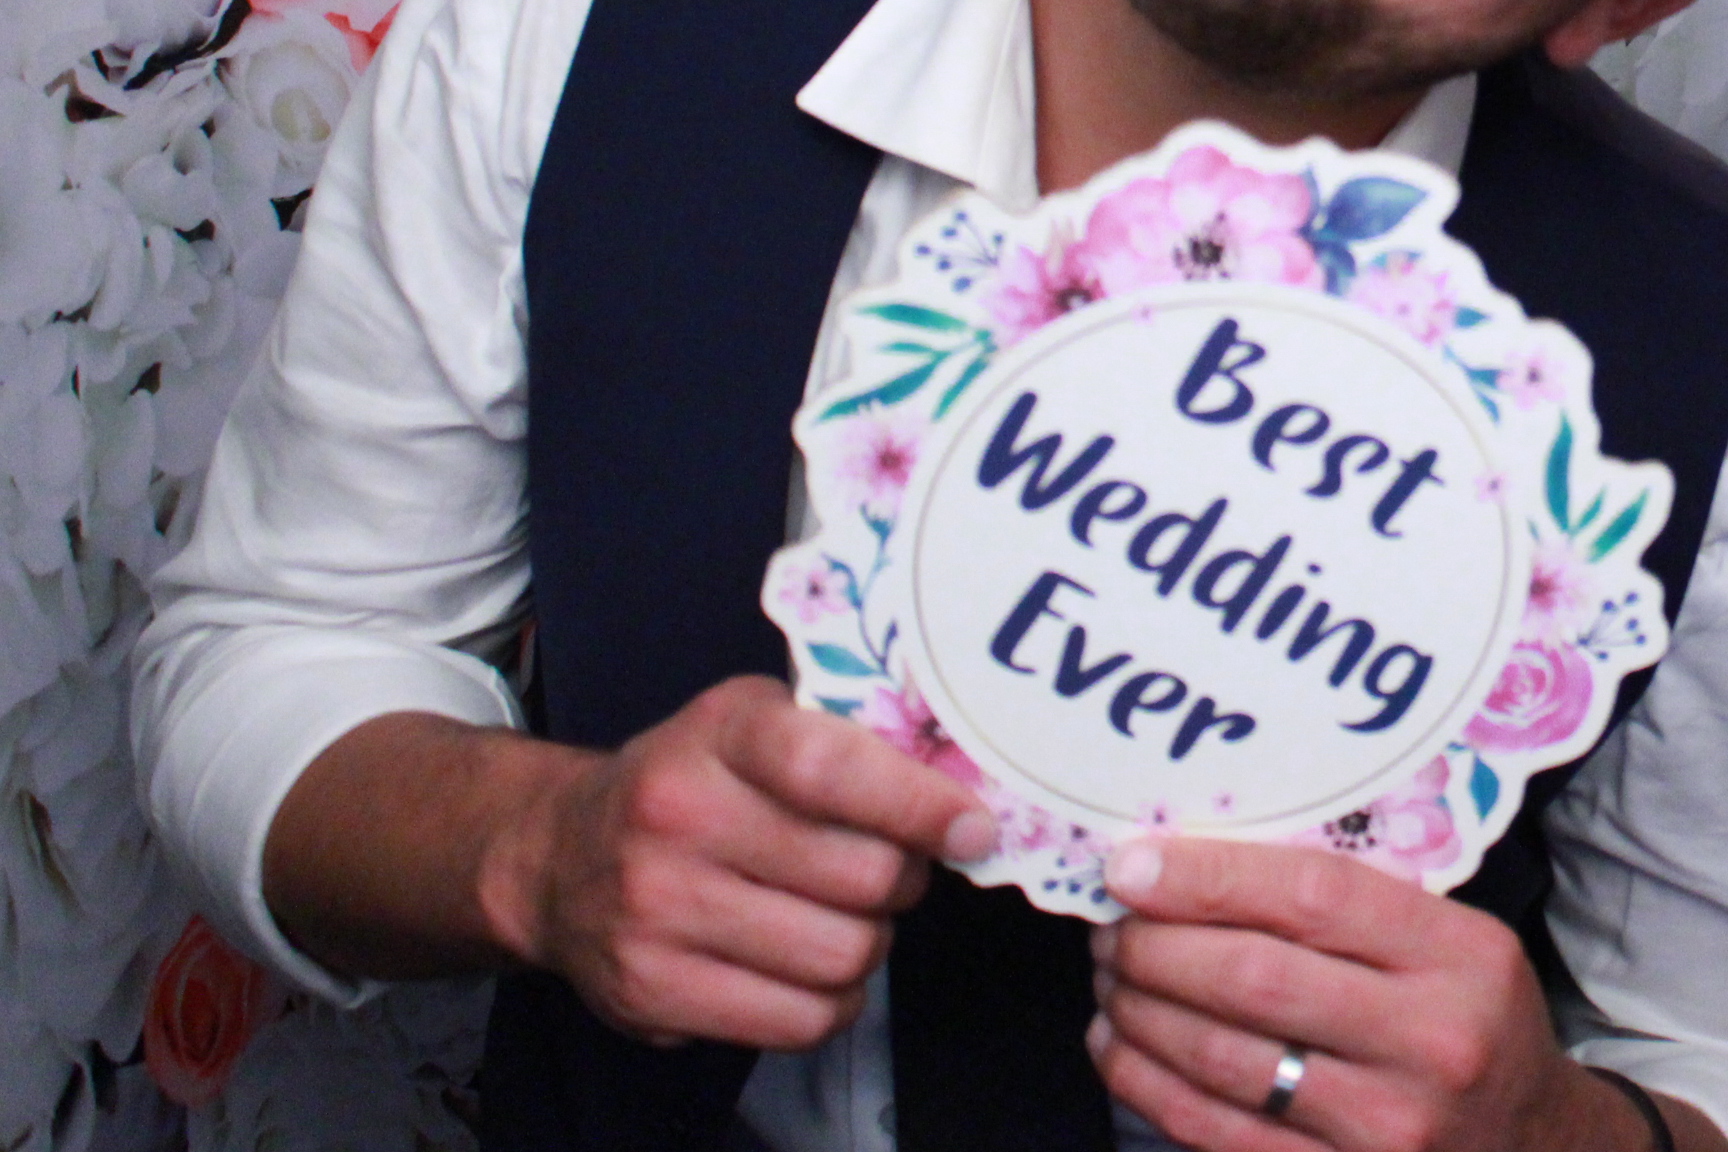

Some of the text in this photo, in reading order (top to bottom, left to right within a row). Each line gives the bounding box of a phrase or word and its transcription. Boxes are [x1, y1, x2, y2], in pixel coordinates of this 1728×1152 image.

[1177, 318, 1444, 537] Best
[976, 391, 1434, 733] Wedding
[989, 570, 1257, 761] Ever
